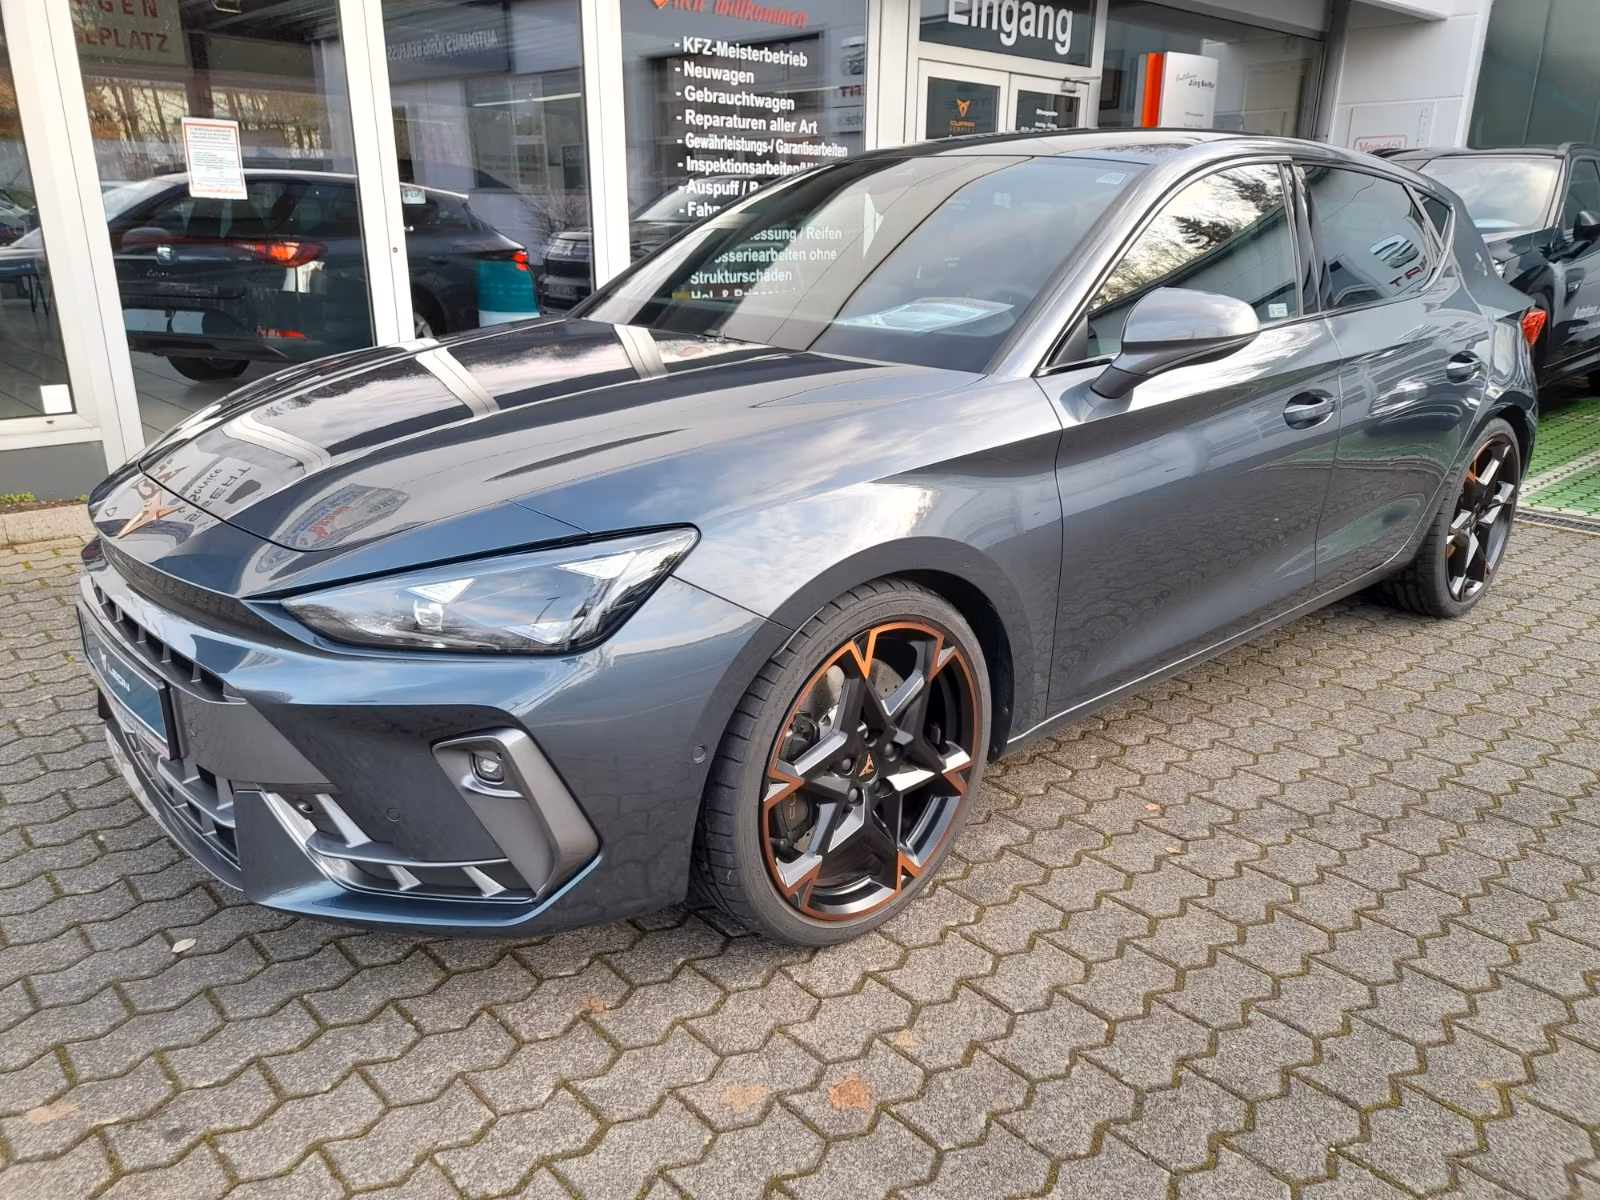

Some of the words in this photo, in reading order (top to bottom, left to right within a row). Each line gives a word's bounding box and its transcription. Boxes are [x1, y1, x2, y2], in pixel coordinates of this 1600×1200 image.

[948, 0, 1073, 55] Eingang
[683, 36, 808, 68] KFZ-Meisterbetrieb
[684, 61, 754, 85] Neuwagen
[684, 85, 794, 112] Gebrauchtwagen
[686, 109, 766, 133] Reparaturen
[770, 119, 796, 133] aller
[798, 118, 818, 134] Art
[776, 138, 848, 158] Garantiearbeiten
[686, 180, 740, 198] Auspuff
[806, 226, 842, 240] Reifen
[810, 248, 836, 261] ohne
[690, 268, 792, 284] Strukturschäden
[107, 663, 130, 692] LEON
